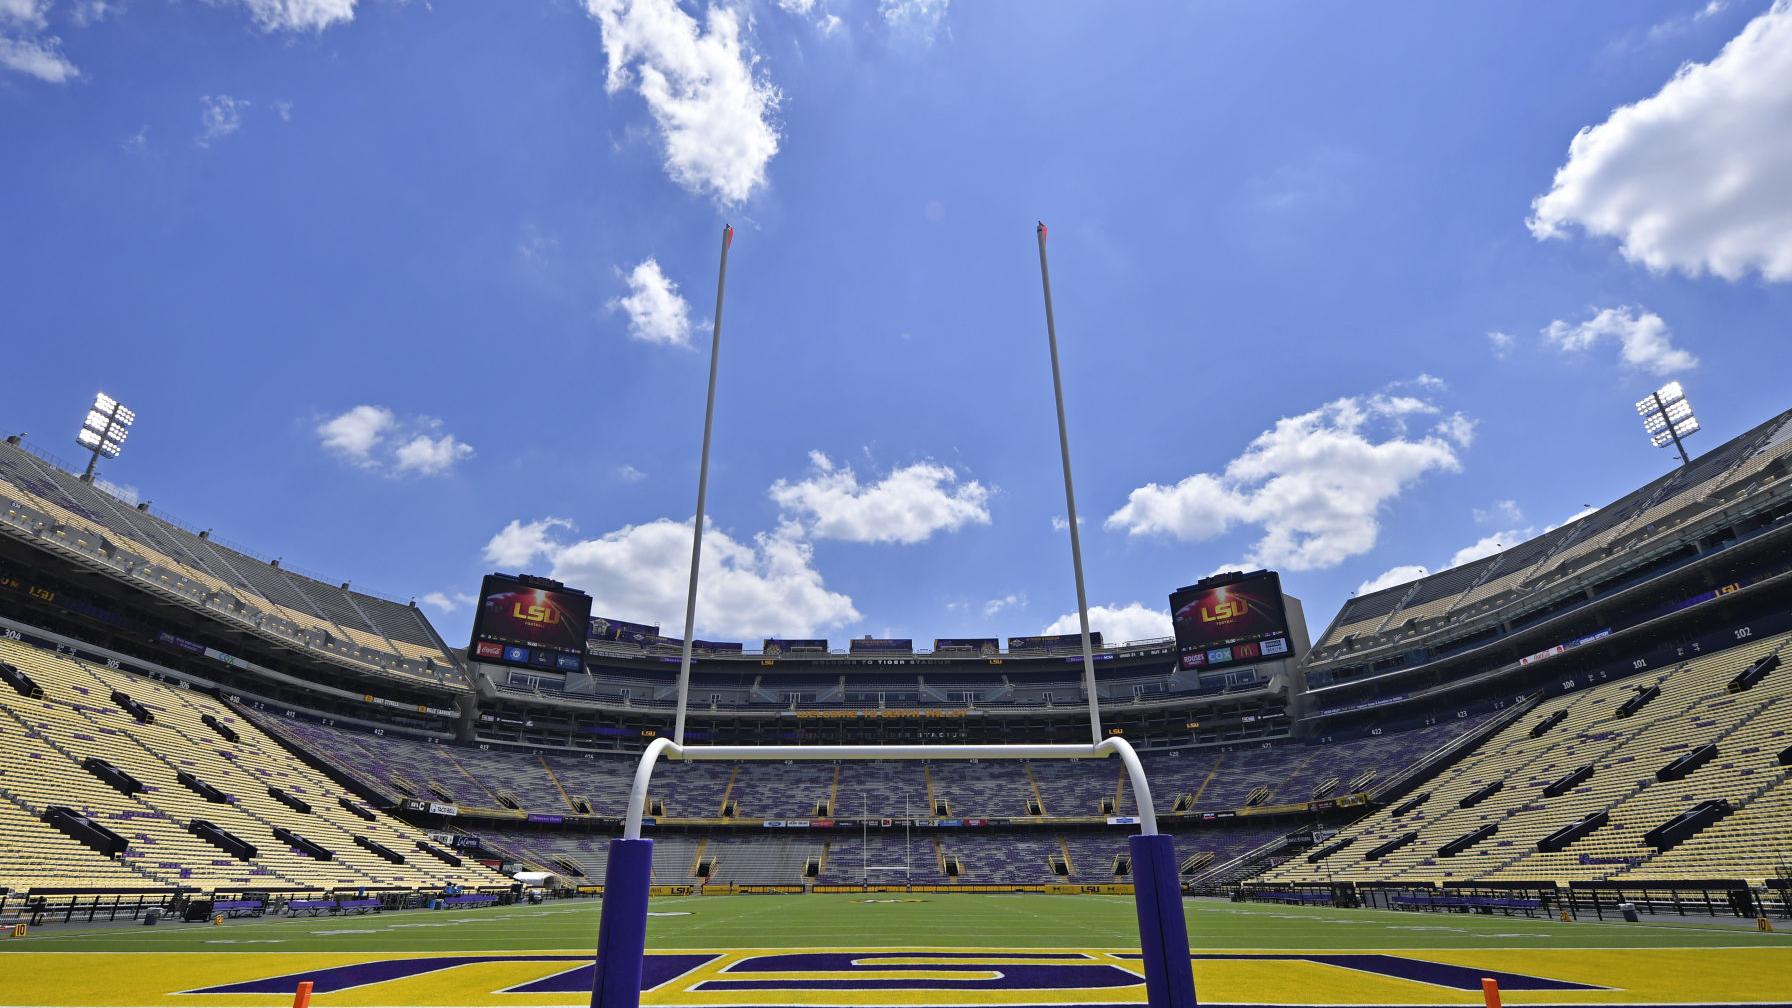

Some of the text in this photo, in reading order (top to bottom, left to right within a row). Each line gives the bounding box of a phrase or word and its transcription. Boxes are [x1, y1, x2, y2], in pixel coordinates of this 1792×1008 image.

[1714, 582, 1740, 599] LSU
[512, 602, 561, 625] LSU
[1201, 600, 1249, 623] LSU
[4, 628, 21, 641] 304
[1734, 626, 1752, 640] 102
[1208, 650, 1232, 661] COX
[106, 658, 120, 670] 305
[1632, 659, 1647, 669] 101
[178, 680, 190, 690] 306
[1562, 680, 1575, 689] 100
[437, 805, 447, 814] TACO
[670, 887, 690, 895] LSU
[16, 924, 26, 936] 10
[1758, 918, 1766, 930] 10
